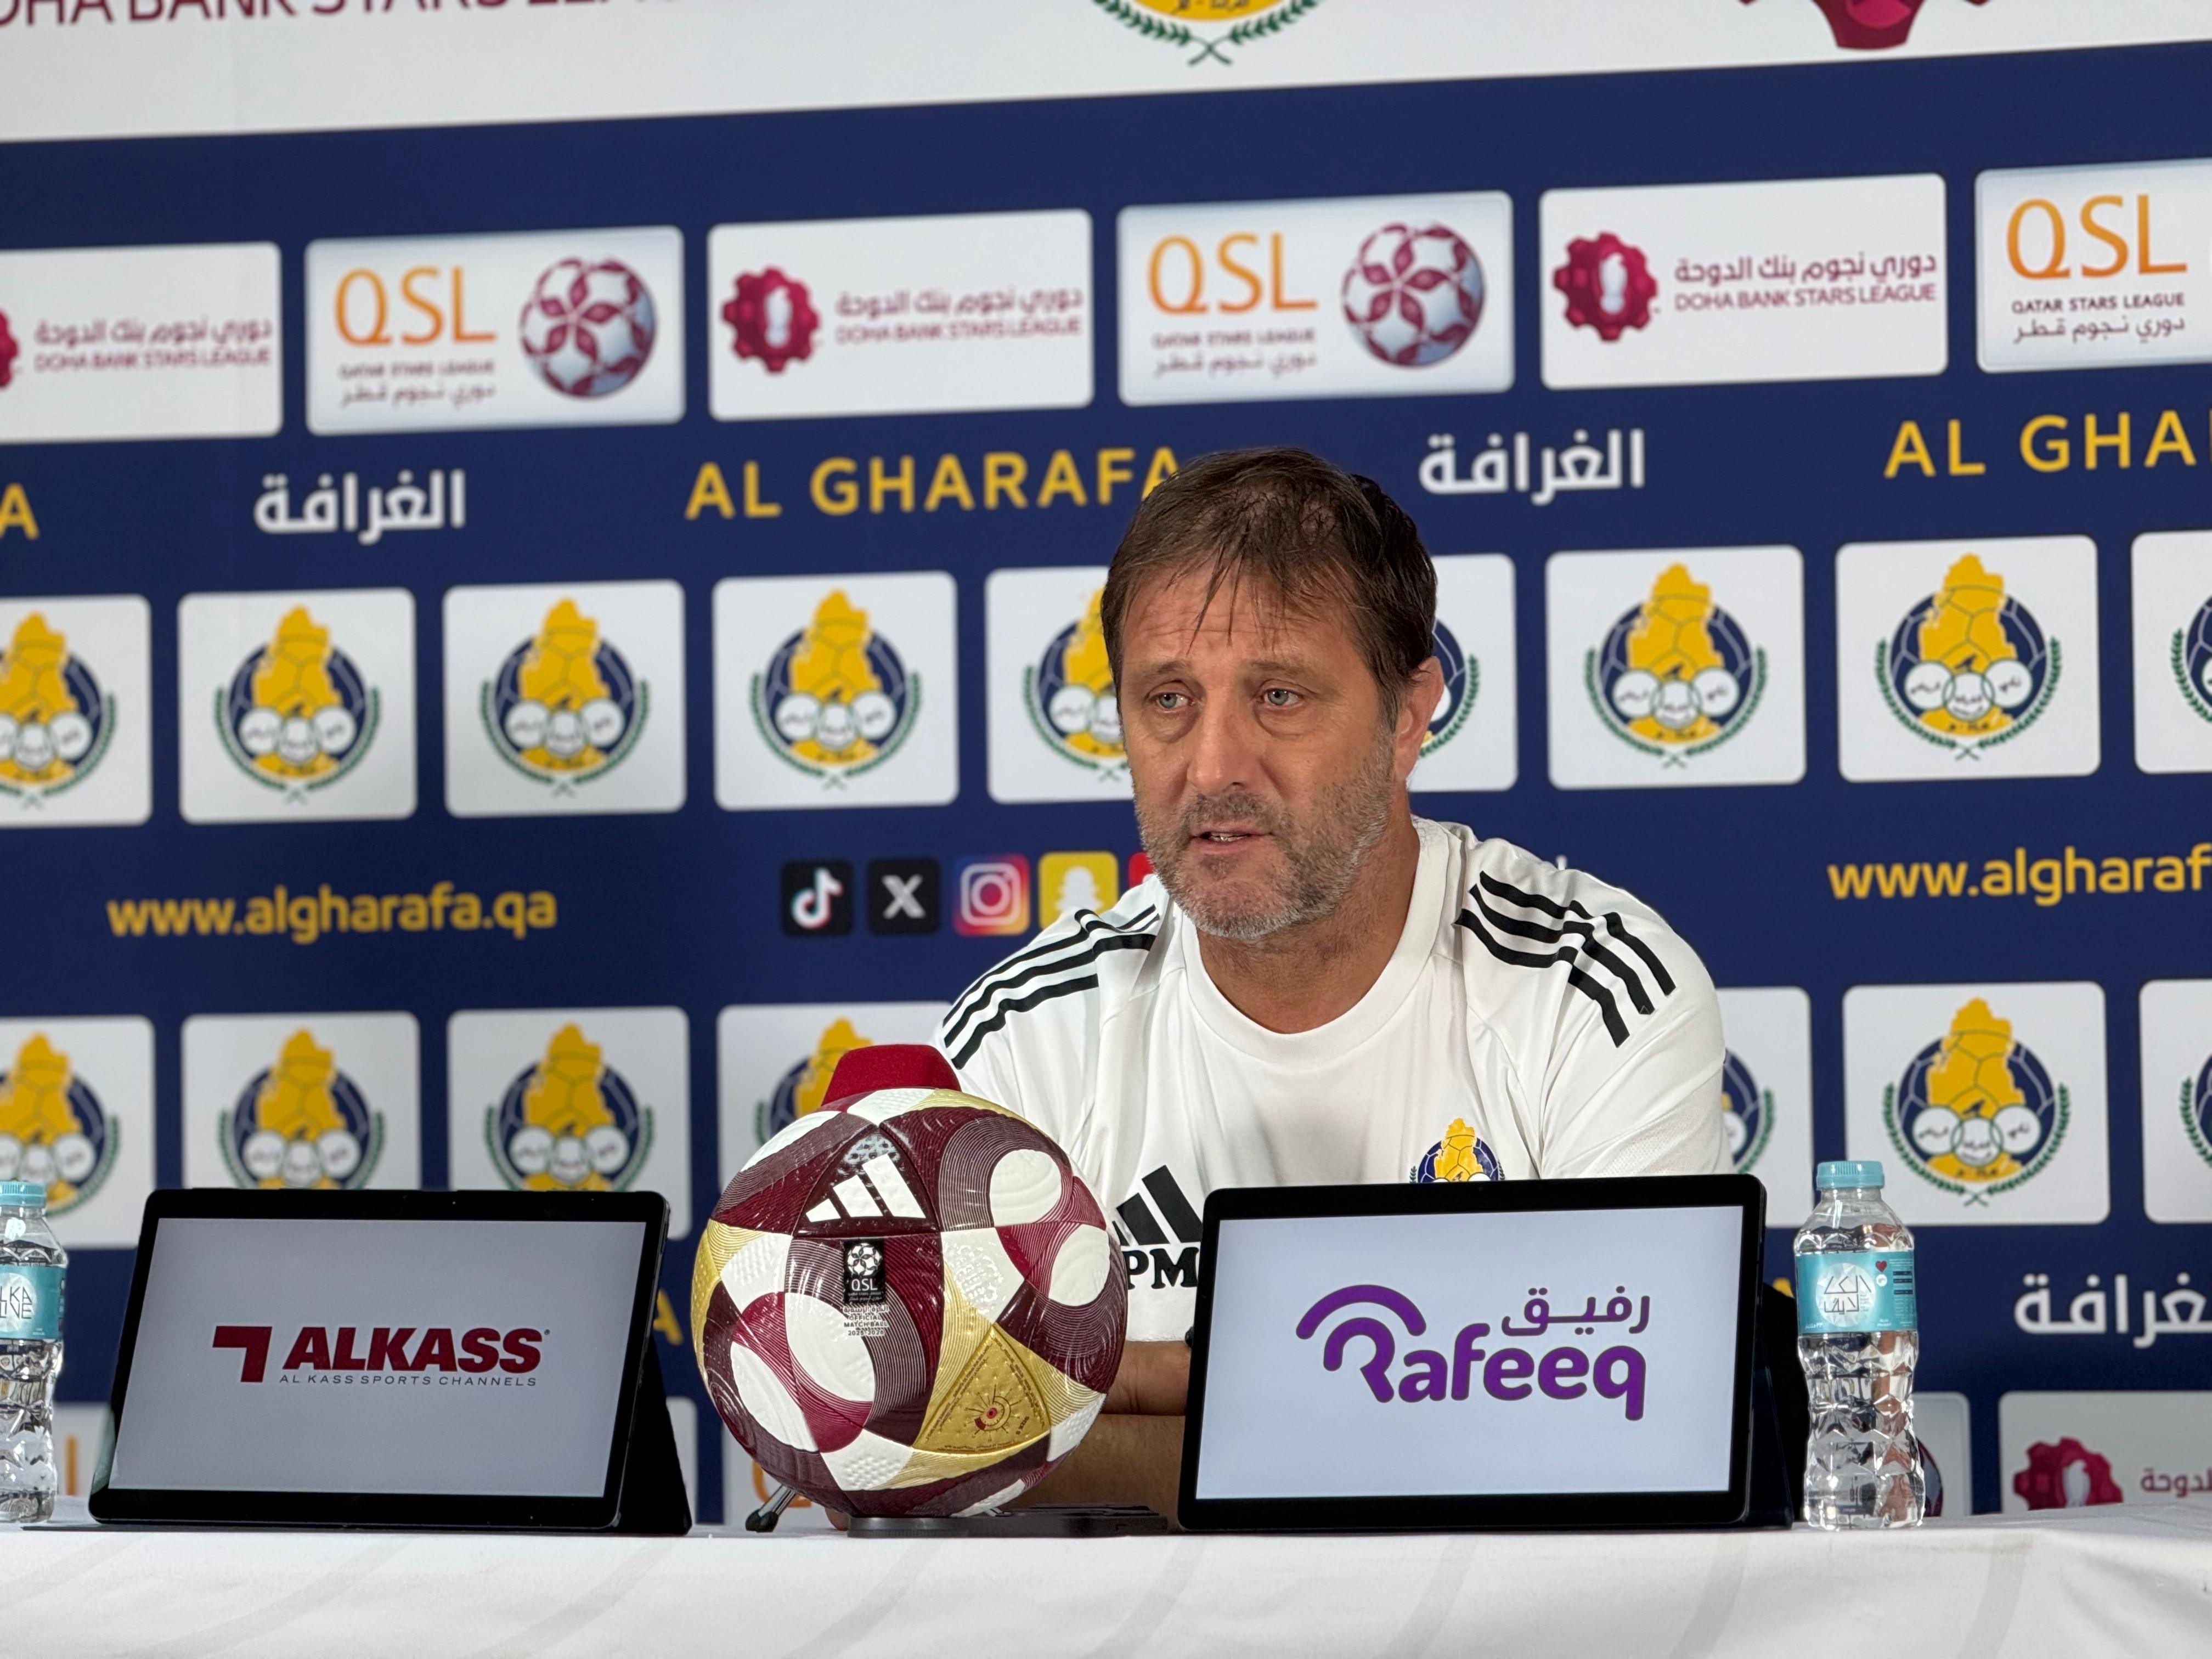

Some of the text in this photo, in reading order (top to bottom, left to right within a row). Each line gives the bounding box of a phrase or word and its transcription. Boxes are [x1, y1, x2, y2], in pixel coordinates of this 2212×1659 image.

[2007, 195, 2187, 280] QSL
[1148, 233, 1318, 315] QSL
[1674, 256, 1753, 287] الدوحة
[1802, 252, 1865, 282] نجوم
[1870, 254, 1937, 284] دوري
[335, 266, 496, 347] QSL
[1675, 283, 1936, 311] DOHA BANK STARS LEAGUE
[2012, 292, 2185, 314] QATAR STARS LEAGUE
[1420, 429, 1644, 505] الغرافة
[1885, 410, 2212, 477] AL GHA
[254, 469, 465, 544] الغرافة
[685, 461, 781, 520] AL
[106, 881, 557, 945] www.algharafa.qa
[851, 1278, 878, 1291] QSL
[1121, 1246, 1199, 1290] PM
[1501, 1285, 1650, 1337] رفيق
[282, 1327, 543, 1374] ALKASS
[1323, 1317, 1646, 1421] Rafeeq
[279, 1374, 537, 1386] AL KASS SPORTS CHANNELS
